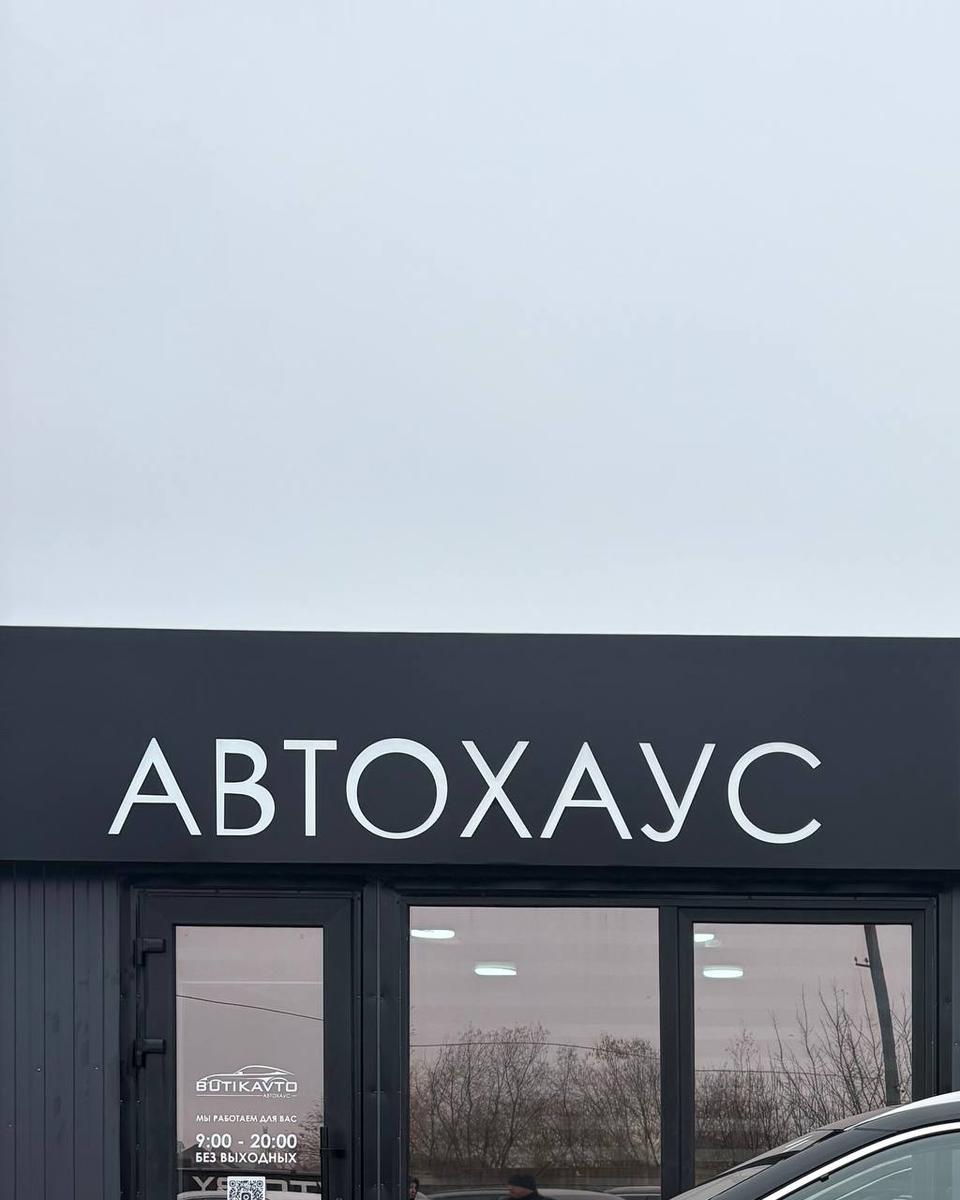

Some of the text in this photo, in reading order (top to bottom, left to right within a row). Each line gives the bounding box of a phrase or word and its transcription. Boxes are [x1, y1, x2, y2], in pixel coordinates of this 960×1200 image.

[108, 737, 823, 845] АВТОХАУС
[196, 1081, 298, 1092] BUTIKAVTO
[196, 1115, 298, 1124] МЫ РАБОТАЕМ ДЛЯ ВАС
[195, 1133, 232, 1149] 9:00
[250, 1133, 298, 1149] 20:00
[195, 1152, 298, 1165] БЕЗ ВЫХОДНЫХ
